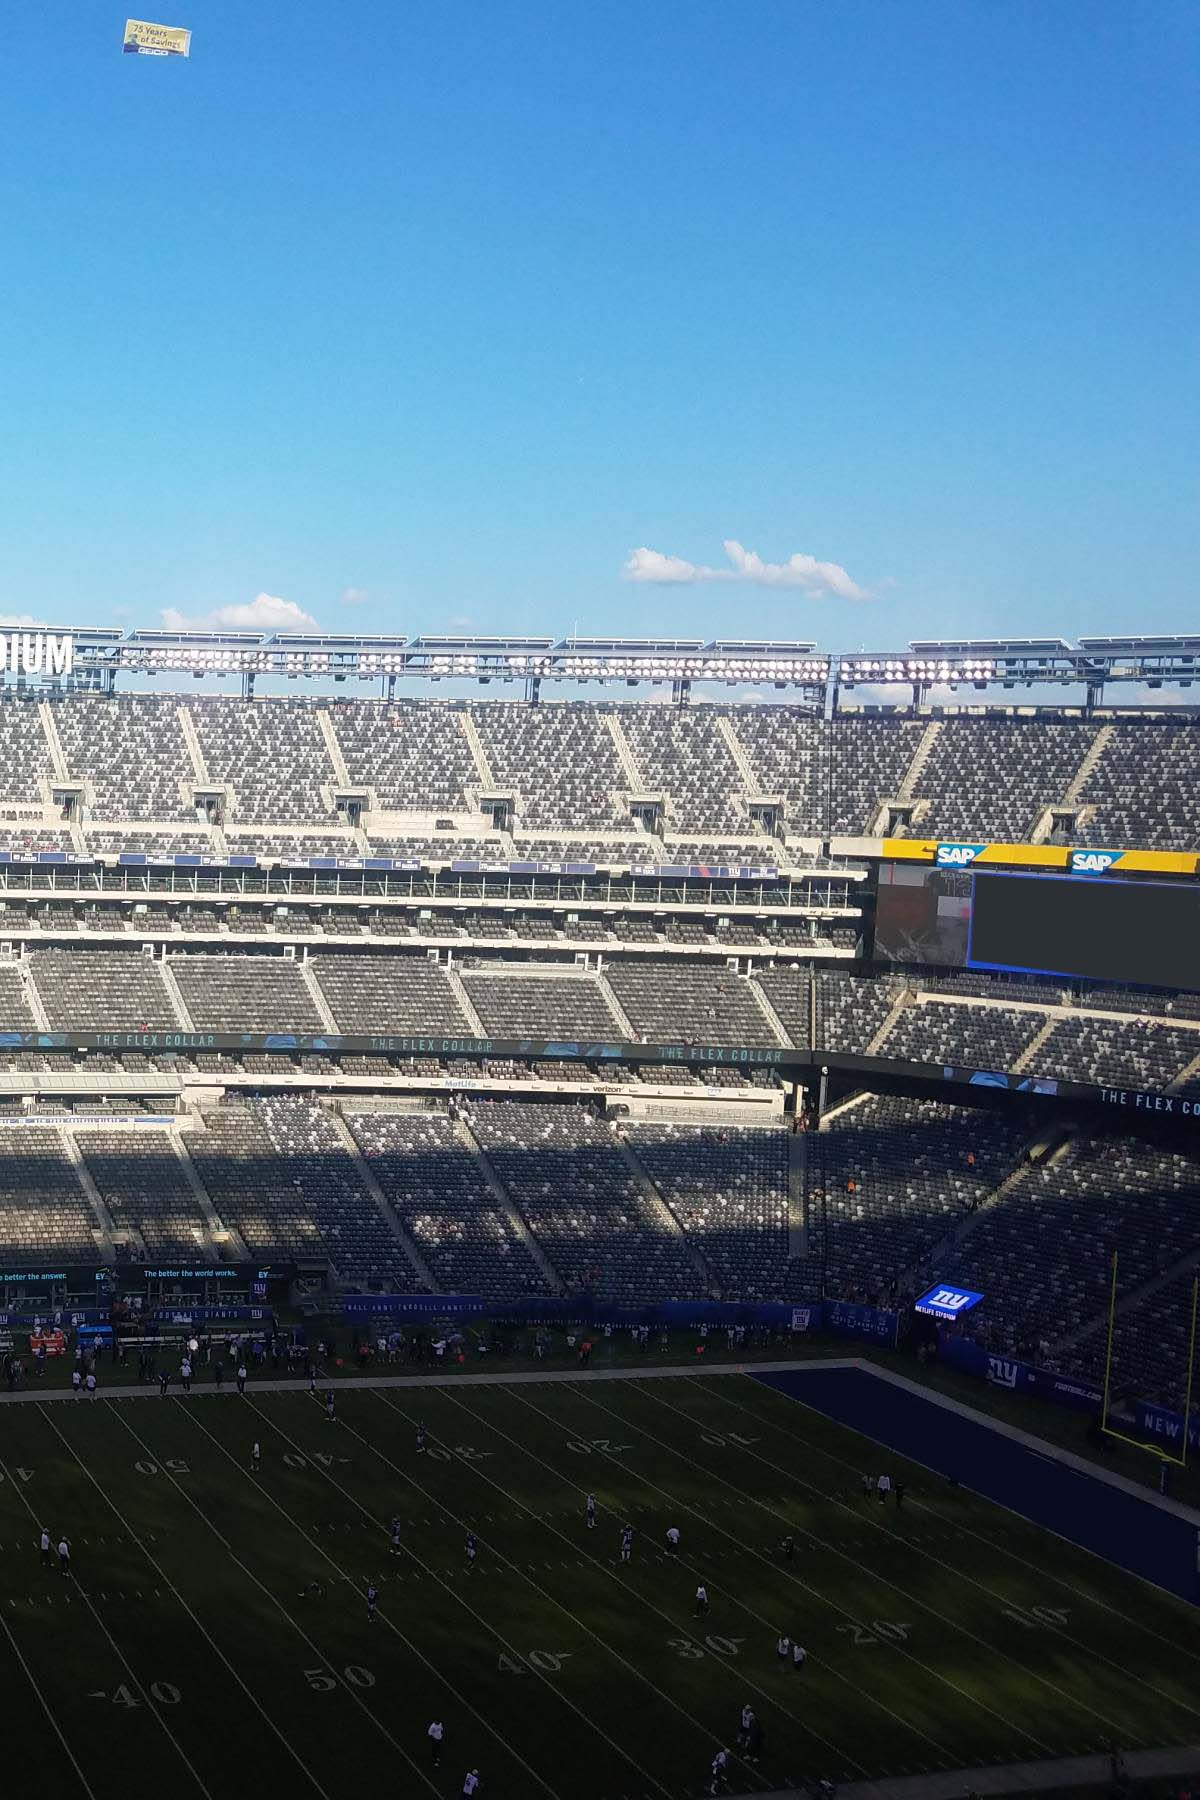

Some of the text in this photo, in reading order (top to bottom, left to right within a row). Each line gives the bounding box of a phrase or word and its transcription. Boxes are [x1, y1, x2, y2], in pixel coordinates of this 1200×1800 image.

[133, 24, 168, 37] 75 Years
[151, 38, 180, 49] Savings
[937, 846, 976, 864] SAP
[1072, 852, 1112, 872] SAP
[96, 1034, 215, 1046] THE FLEX COLLAR
[370, 1038, 493, 1052] THE FLEX COLLAR
[658, 1046, 782, 1062] THE FLEX COLLAR
[444, 1080, 476, 1088] MetLife
[1101, 1089, 1127, 1104] THE
[1136, 1094, 1173, 1112] FLEX
[96, 1272, 106, 1280] EY
[144, 1270, 156, 1278] The
[158, 1270, 182, 1278] better
[183, 1270, 195, 1278] the
[196, 1270, 218, 1278] world
[928, 1290, 970, 1310] ny
[915, 1304, 934, 1316] METLIFE
[1144, 1413, 1180, 1438] NEW
[497, 1650, 564, 1676] 40
[304, 1665, 376, 1692] 50
[110, 1681, 182, 1709] 40
